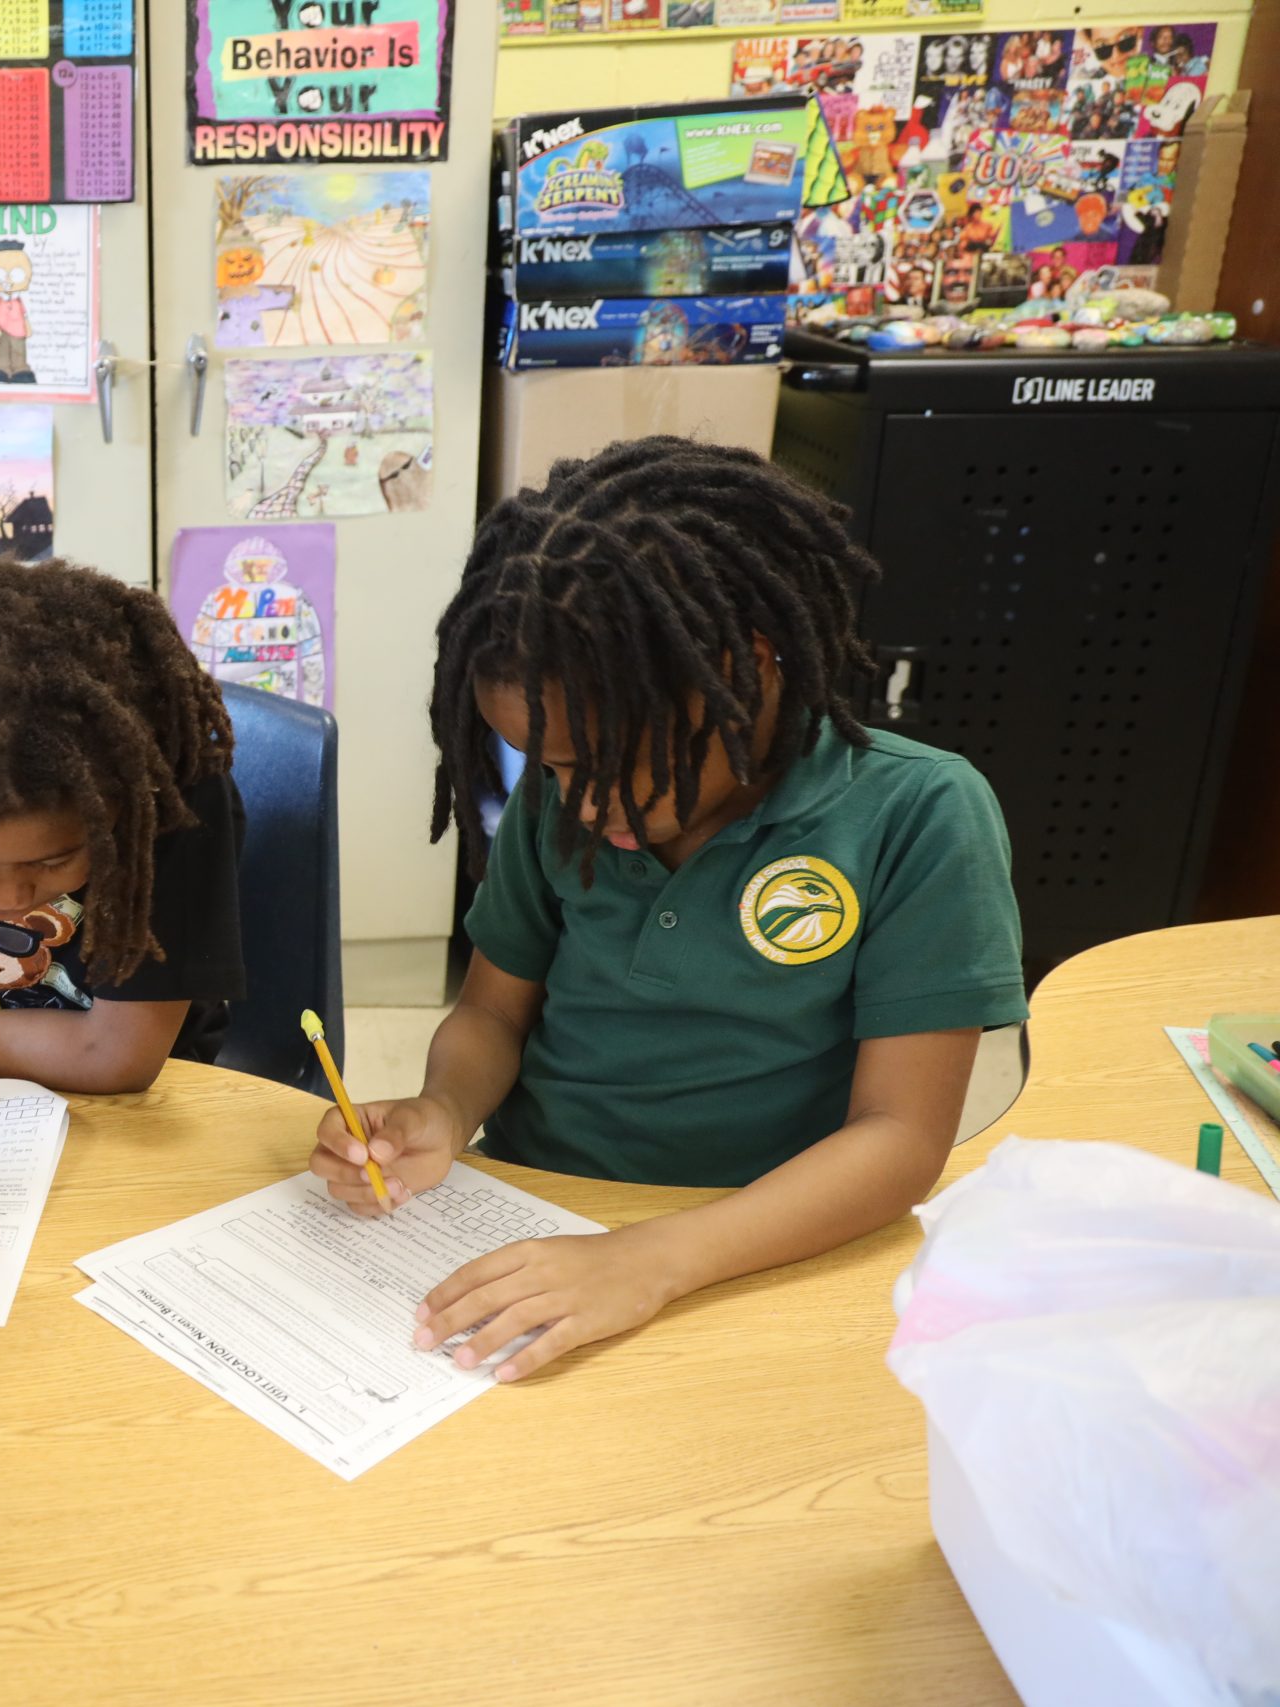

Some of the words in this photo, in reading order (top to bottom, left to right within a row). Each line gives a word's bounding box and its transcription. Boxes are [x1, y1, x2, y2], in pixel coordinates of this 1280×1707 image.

[232, 39, 374, 70] Behavior
[388, 37, 413, 67] Is
[268, 76, 377, 114] Your
[194, 121, 445, 159] RESPONSIBILITY
[1044, 378, 1086, 402] LINE
[1087, 378, 1155, 402] LEADER
[137, 1288, 171, 1316] Burrow
[171, 1311, 205, 1341] Niven's
[261, 1380, 288, 1402] VISIT
